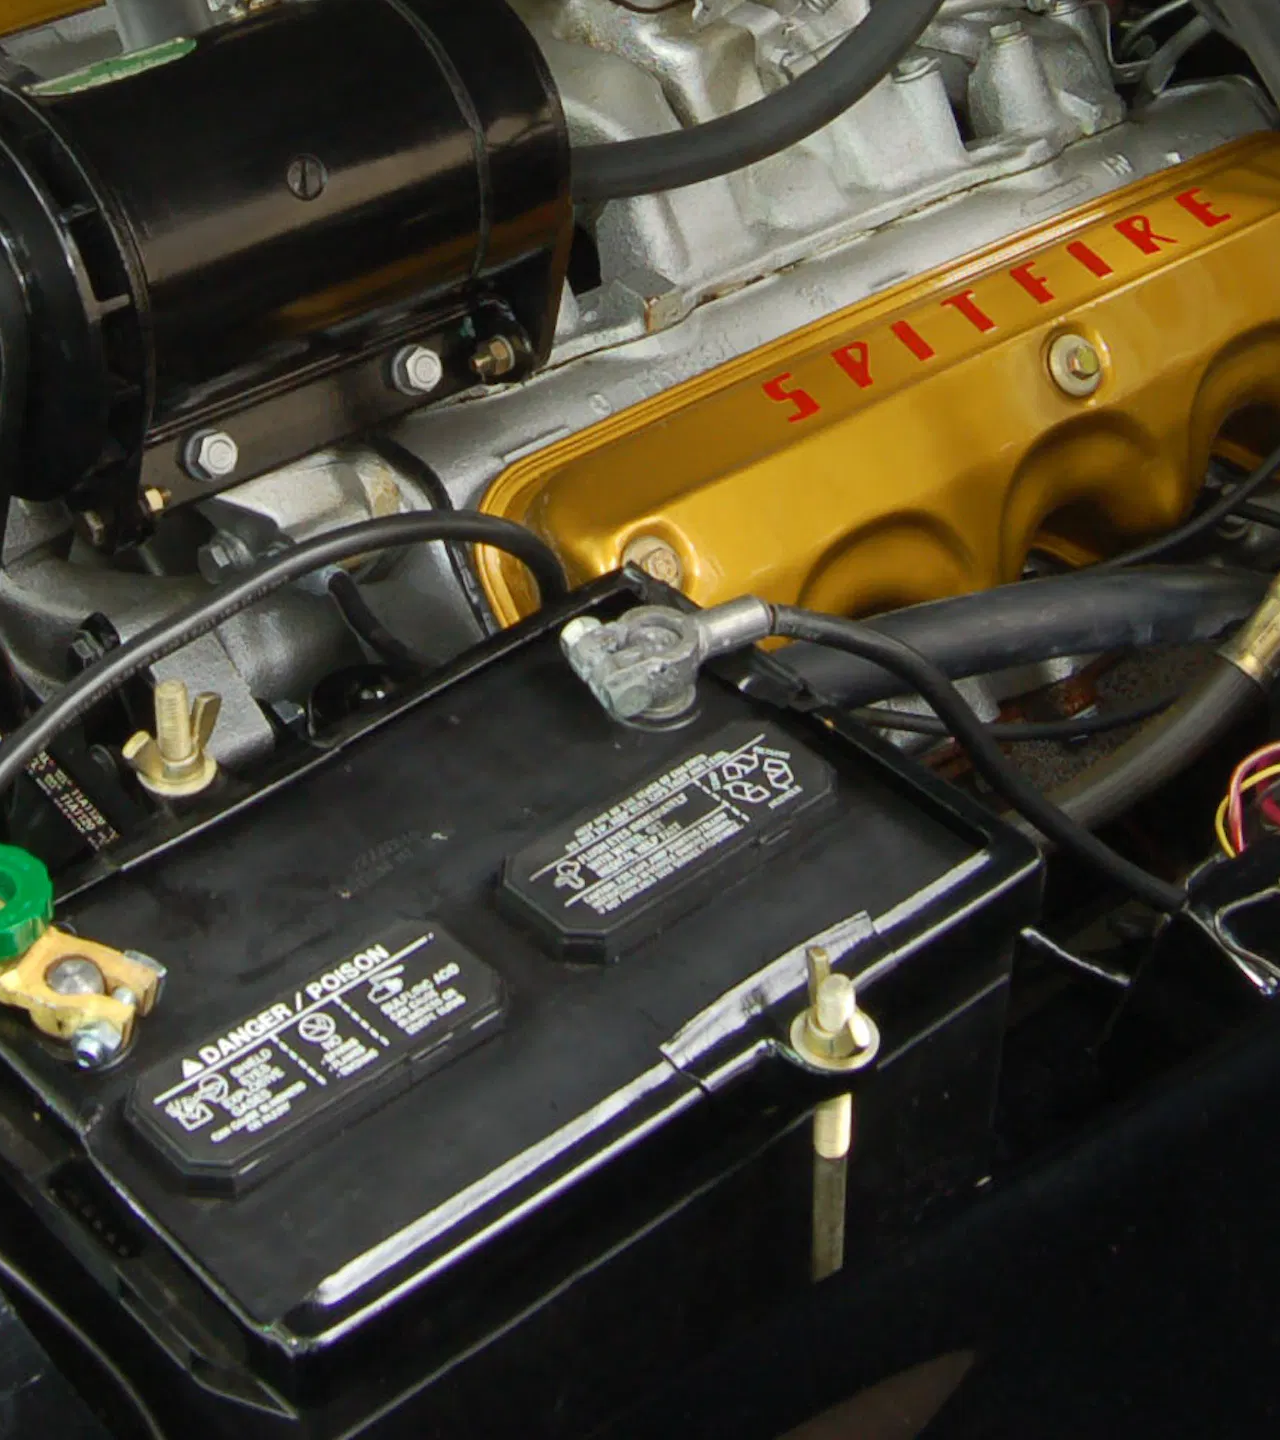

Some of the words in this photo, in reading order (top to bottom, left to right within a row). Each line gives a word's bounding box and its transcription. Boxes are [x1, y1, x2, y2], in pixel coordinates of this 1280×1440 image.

[762, 186, 1231, 423] SPITFIRE
[199, 1003, 293, 1066] DANGER
[305, 944, 390, 1000] POISON
